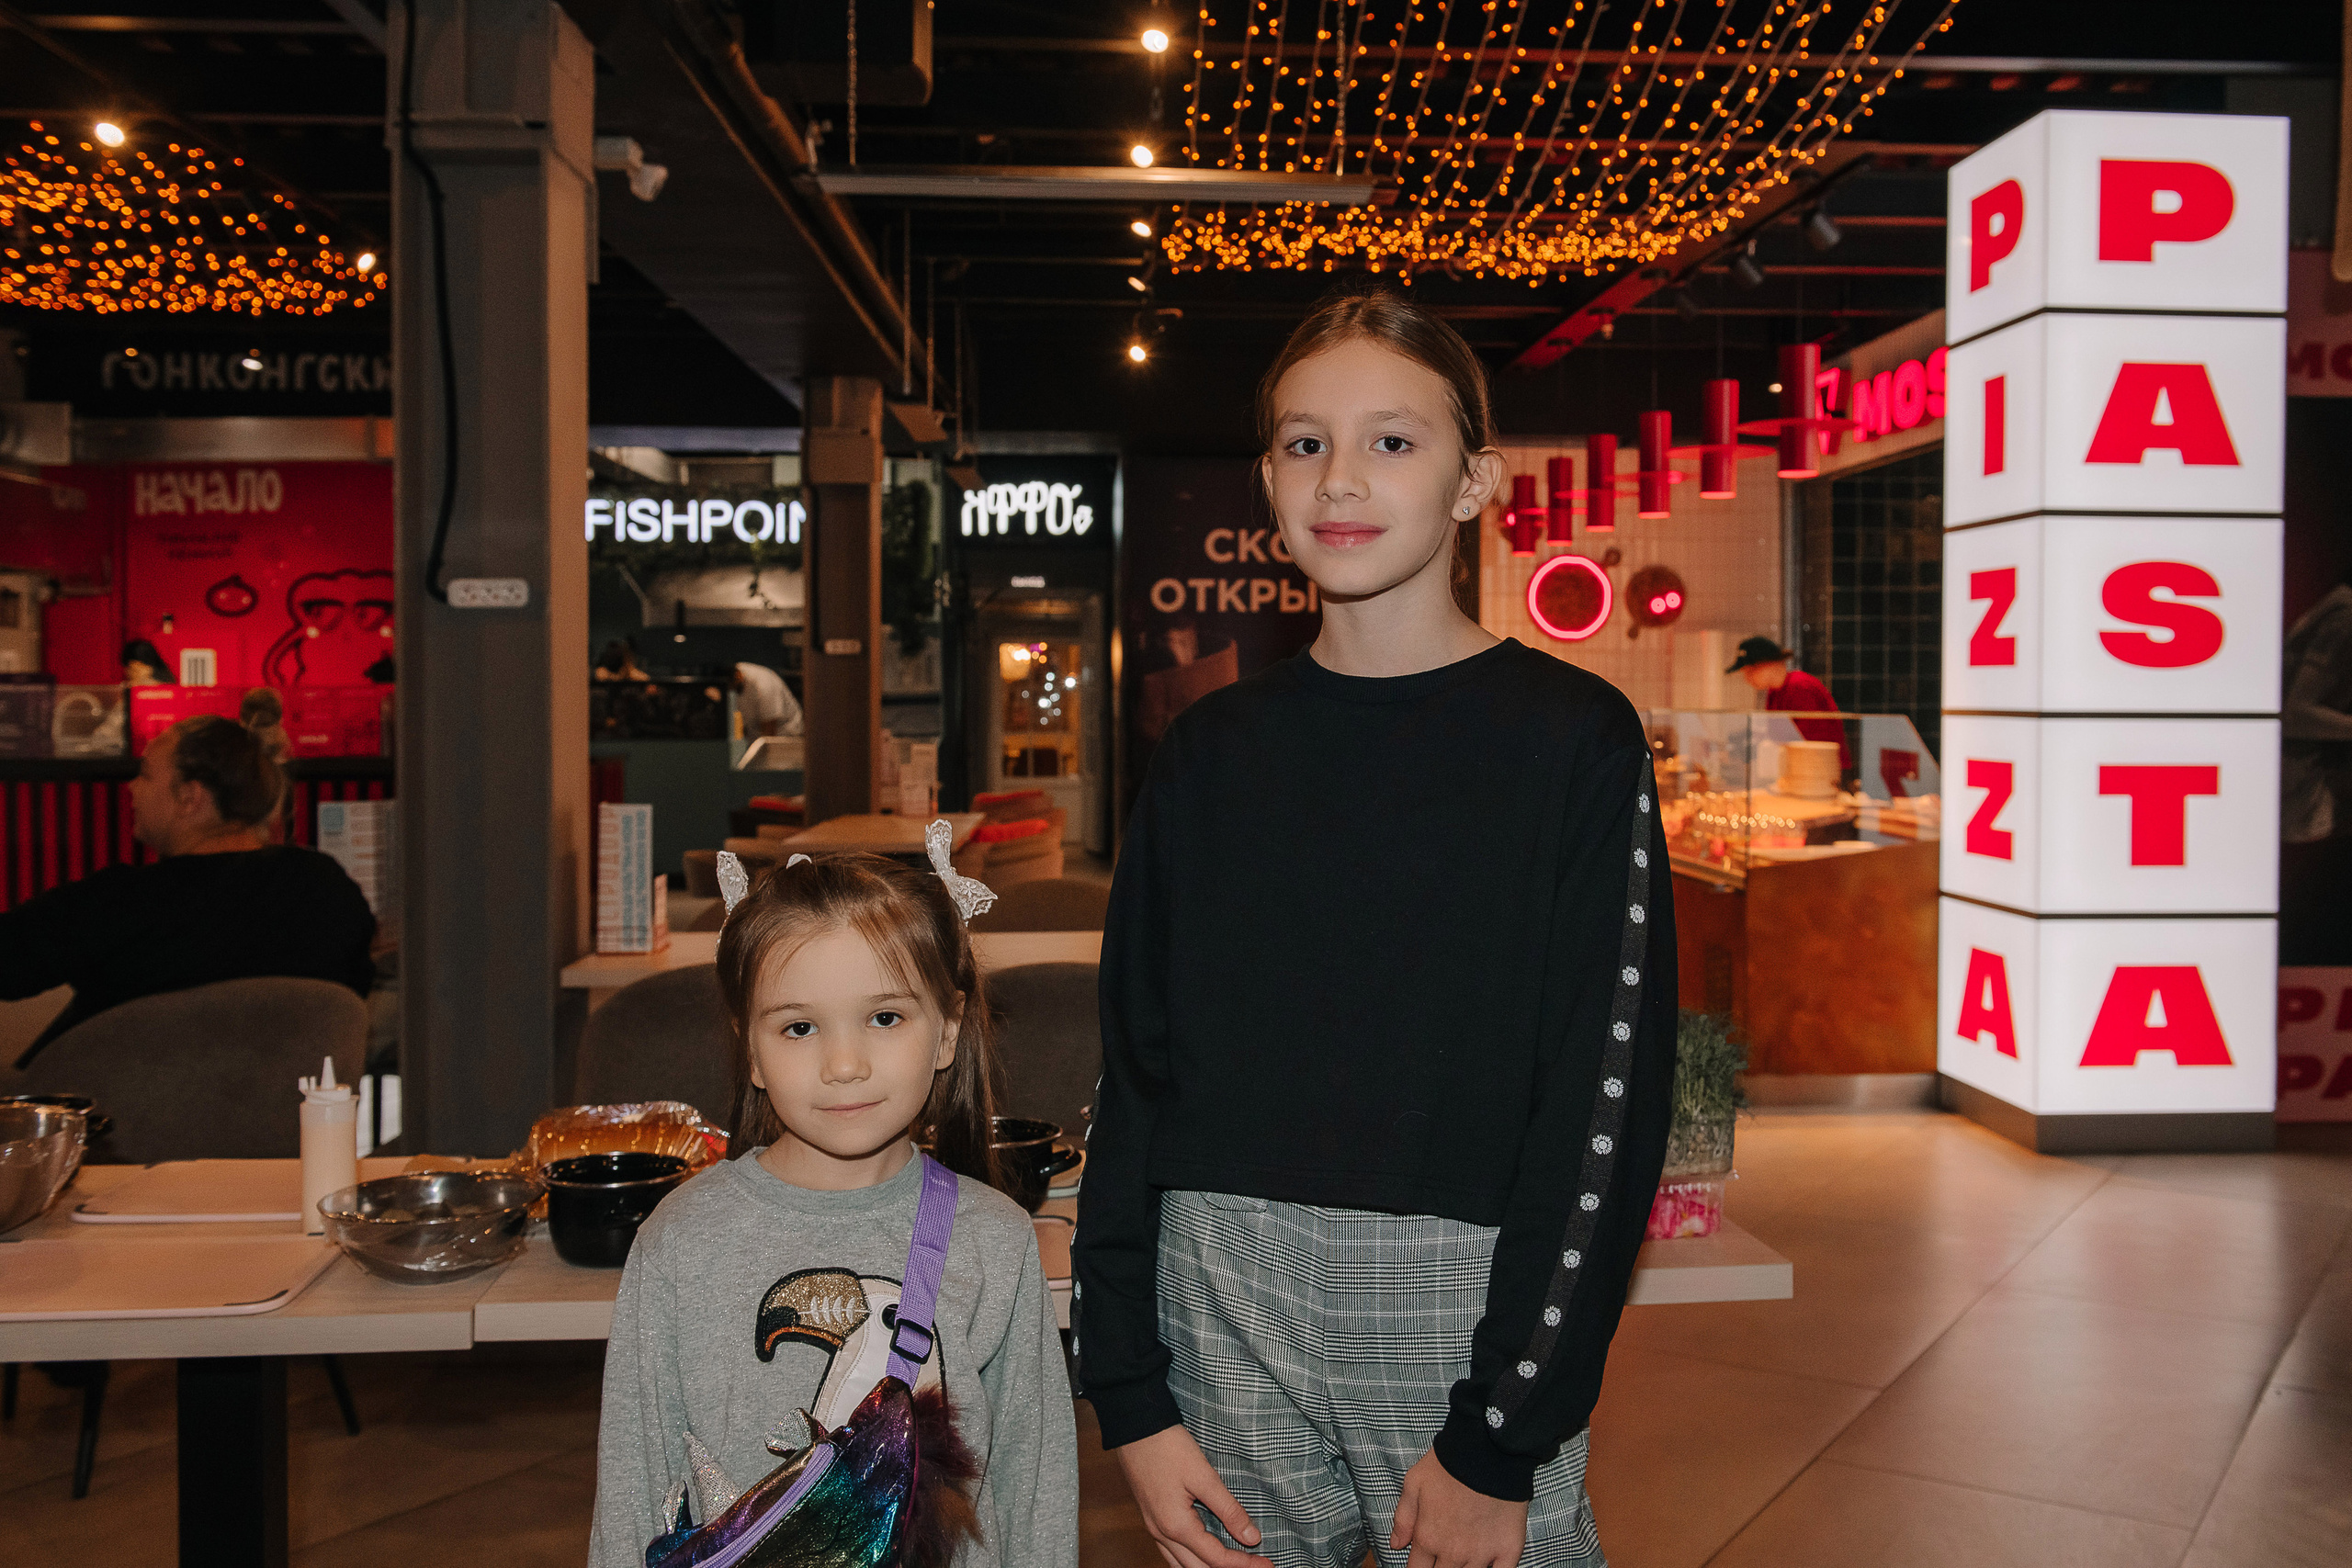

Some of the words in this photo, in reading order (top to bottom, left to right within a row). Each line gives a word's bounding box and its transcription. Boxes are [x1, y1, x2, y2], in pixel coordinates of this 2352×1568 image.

[1149, 578, 1319, 614] ОТКРЫ
[1957, 178, 2023, 1060] PIZZA
[2078, 158, 2242, 1067] PASTA
